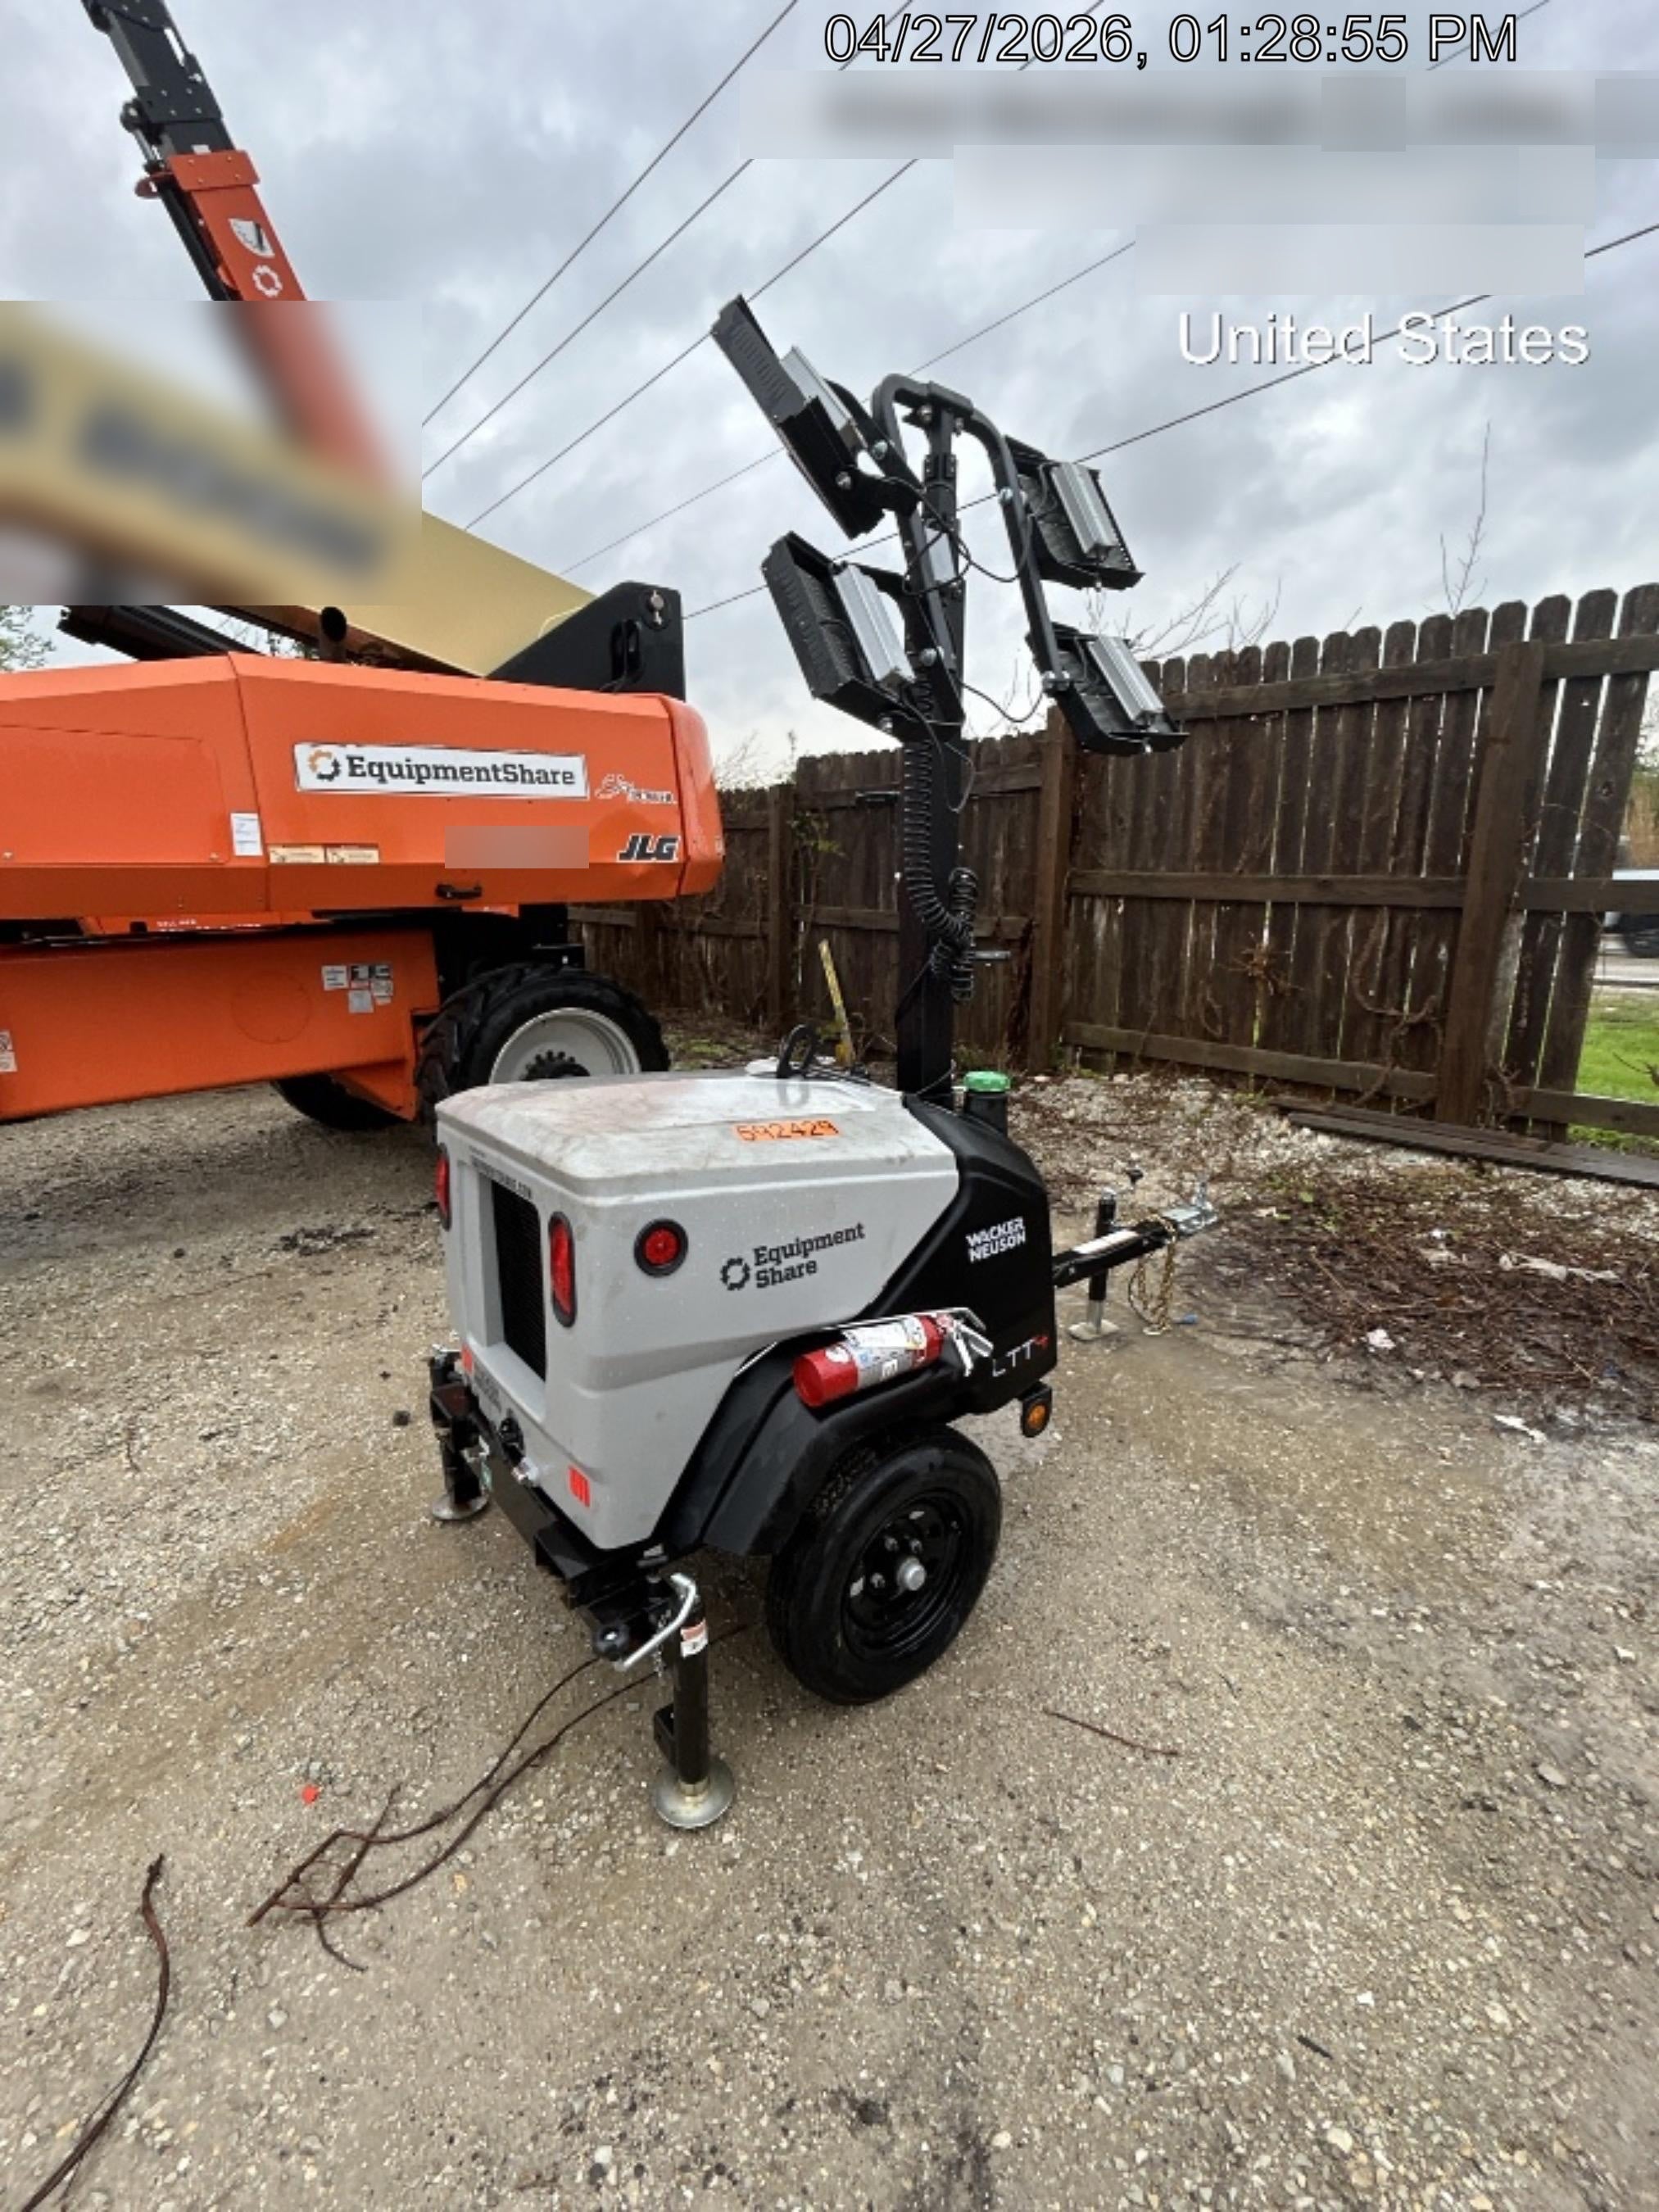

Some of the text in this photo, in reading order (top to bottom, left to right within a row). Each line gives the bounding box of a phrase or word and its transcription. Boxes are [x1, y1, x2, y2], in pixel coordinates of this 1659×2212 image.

[346, 755, 575, 785] EquipmentShare
[616, 833, 679, 863] JLG
[753, 1222, 865, 1267] Equipment
[966, 1217, 1024, 1247] WACKER
[968, 1231, 1026, 1262] NEUSON
[755, 1259, 818, 1289] Share
